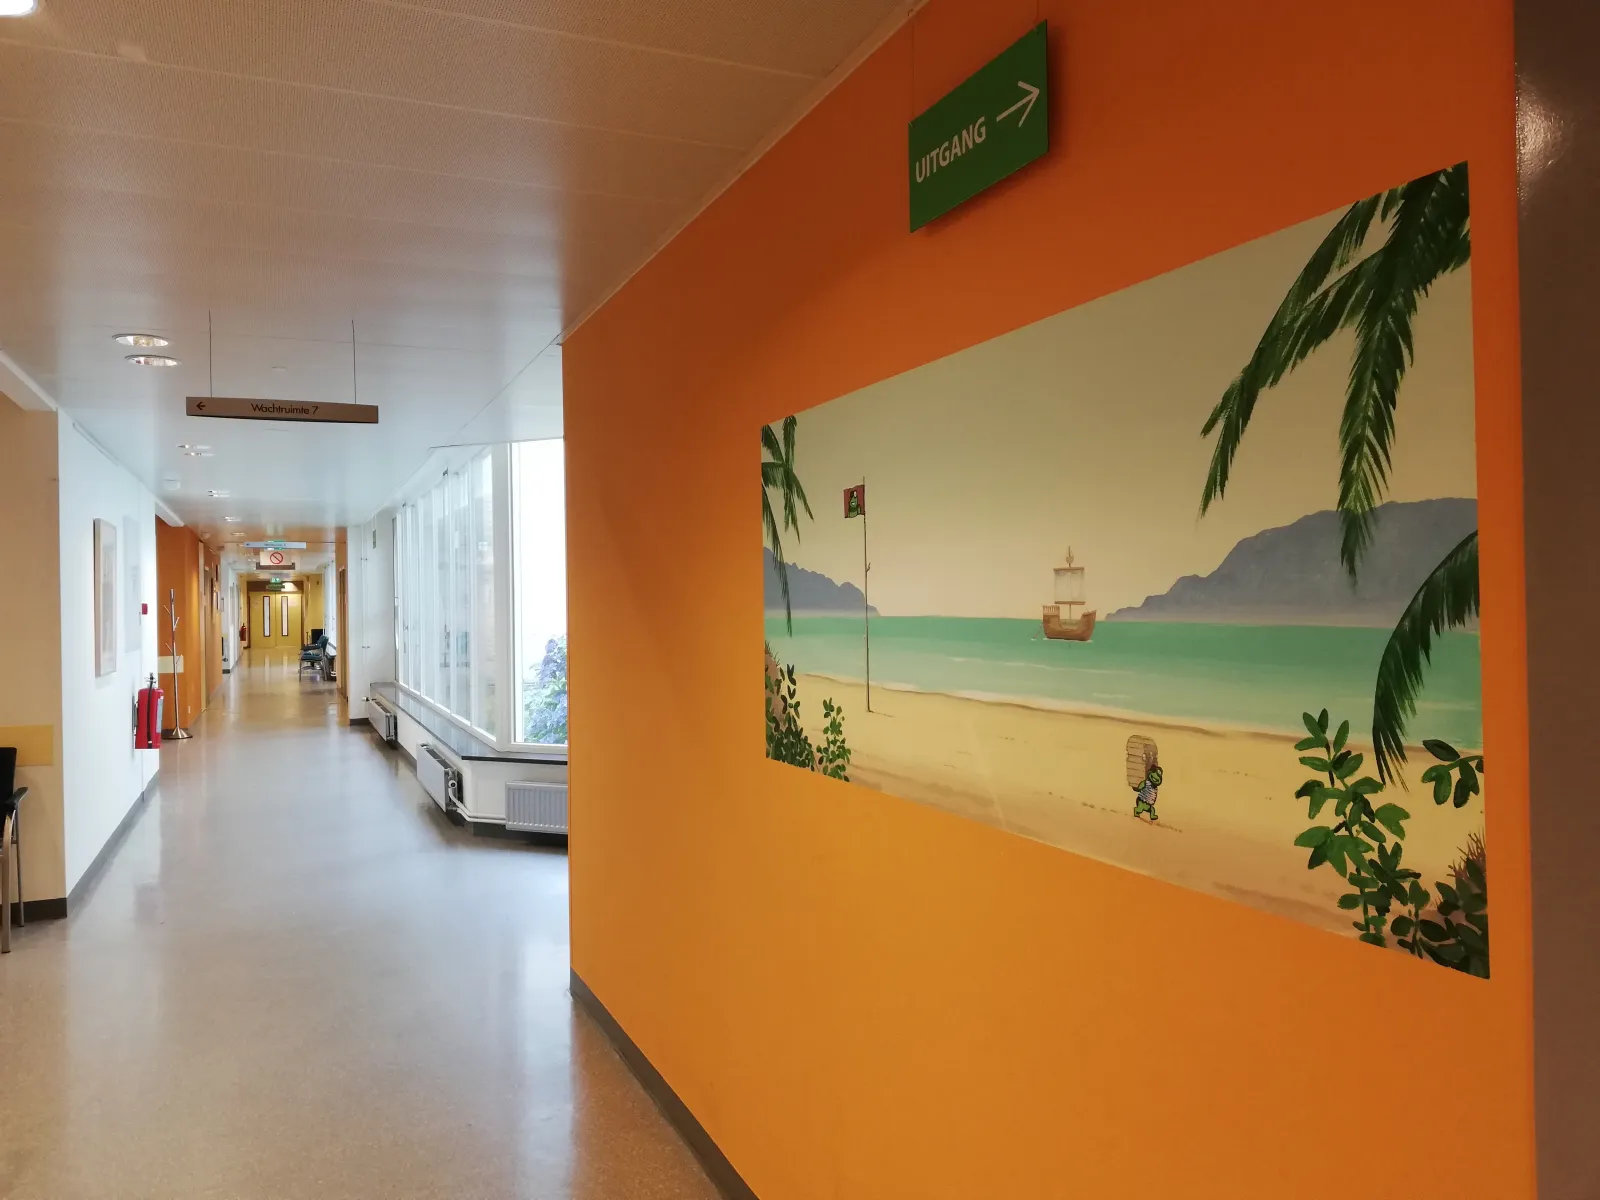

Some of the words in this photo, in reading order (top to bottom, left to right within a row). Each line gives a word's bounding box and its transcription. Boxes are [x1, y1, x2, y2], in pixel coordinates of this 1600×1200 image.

[915, 115, 986, 183] UITGANG
[250, 402, 310, 415] Wachtruimte
[311, 405, 319, 415] 7
